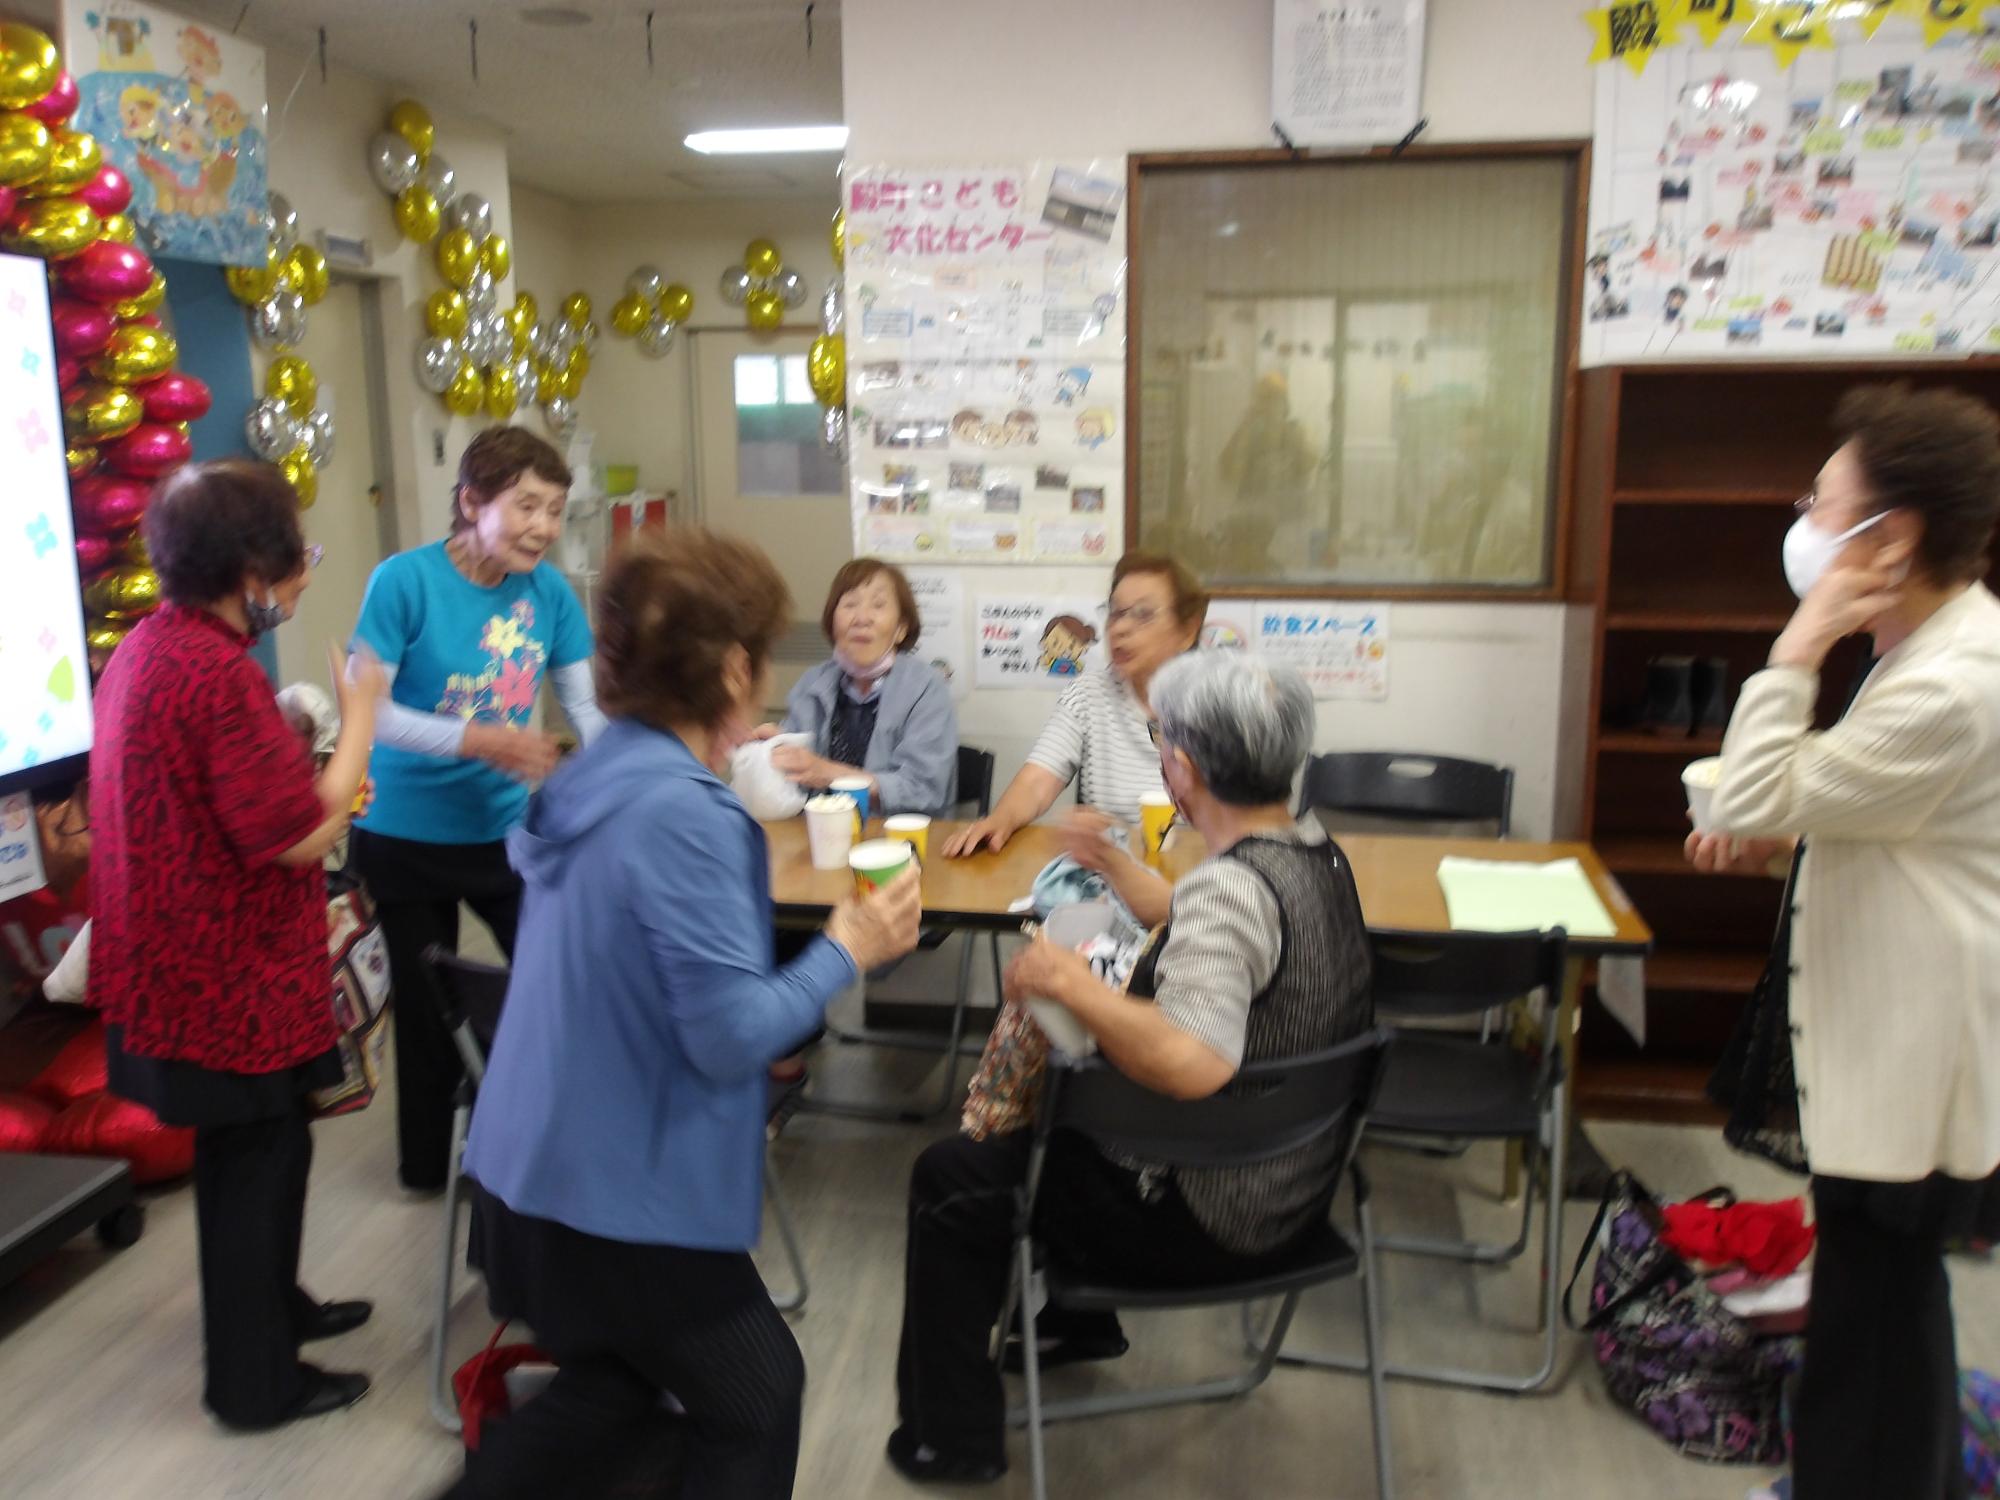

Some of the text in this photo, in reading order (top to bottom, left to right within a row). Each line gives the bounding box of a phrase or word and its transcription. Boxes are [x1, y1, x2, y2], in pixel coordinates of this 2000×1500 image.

[884, 223, 1051, 255] 文化センター
